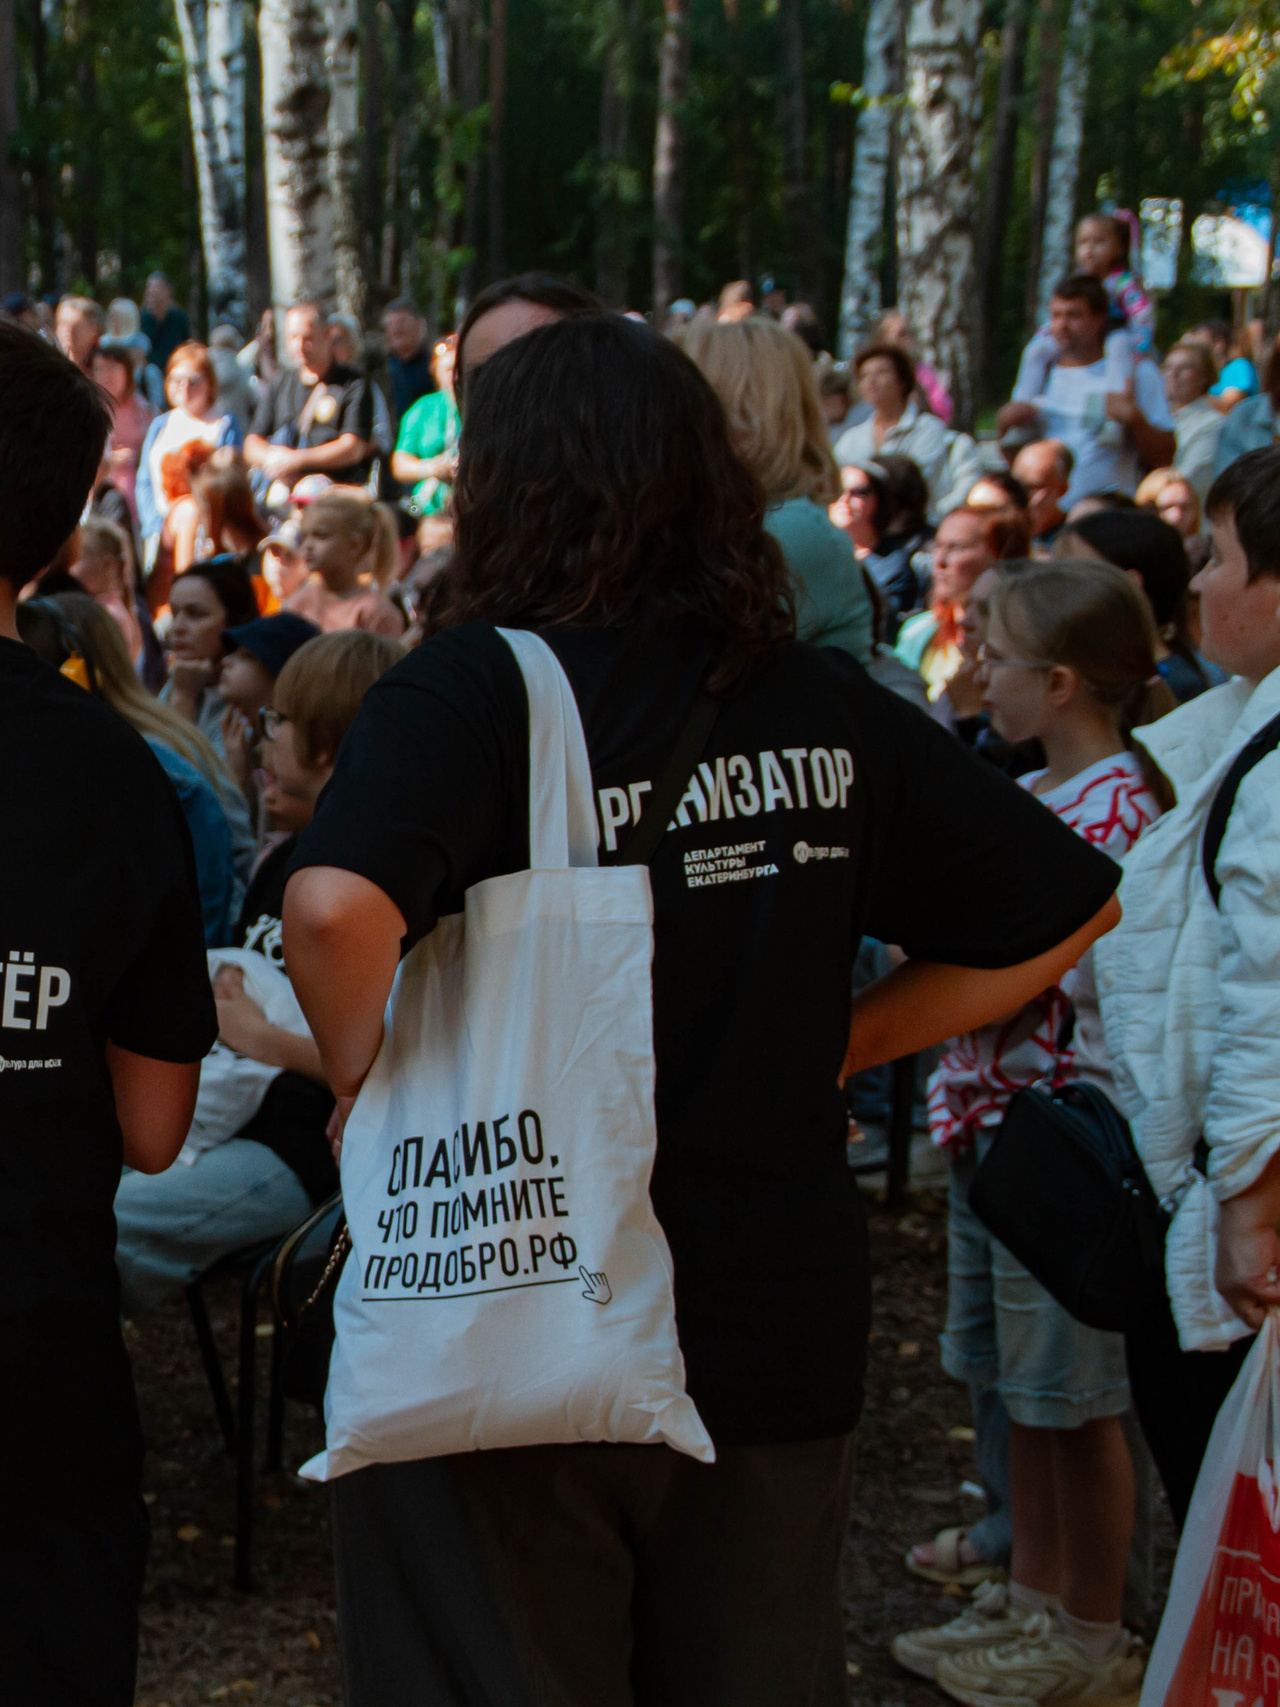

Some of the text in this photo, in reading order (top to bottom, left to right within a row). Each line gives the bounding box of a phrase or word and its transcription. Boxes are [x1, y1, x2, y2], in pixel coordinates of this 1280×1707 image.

[597, 747, 855, 852] РГНИЗАТОР
[683, 839, 767, 863] ДЕПАРТАМЕНТ
[685, 856, 746, 876] КУЛЬТУРЫ
[687, 863, 780, 889] ЕКАТЕРИНБУРГА
[387, 1109, 560, 1197] СПАСИБО,
[377, 1176, 570, 1244] ЧТО ПОМНИТЕ
[363, 1232, 578, 1294] ПРОДОБРО.РФ
